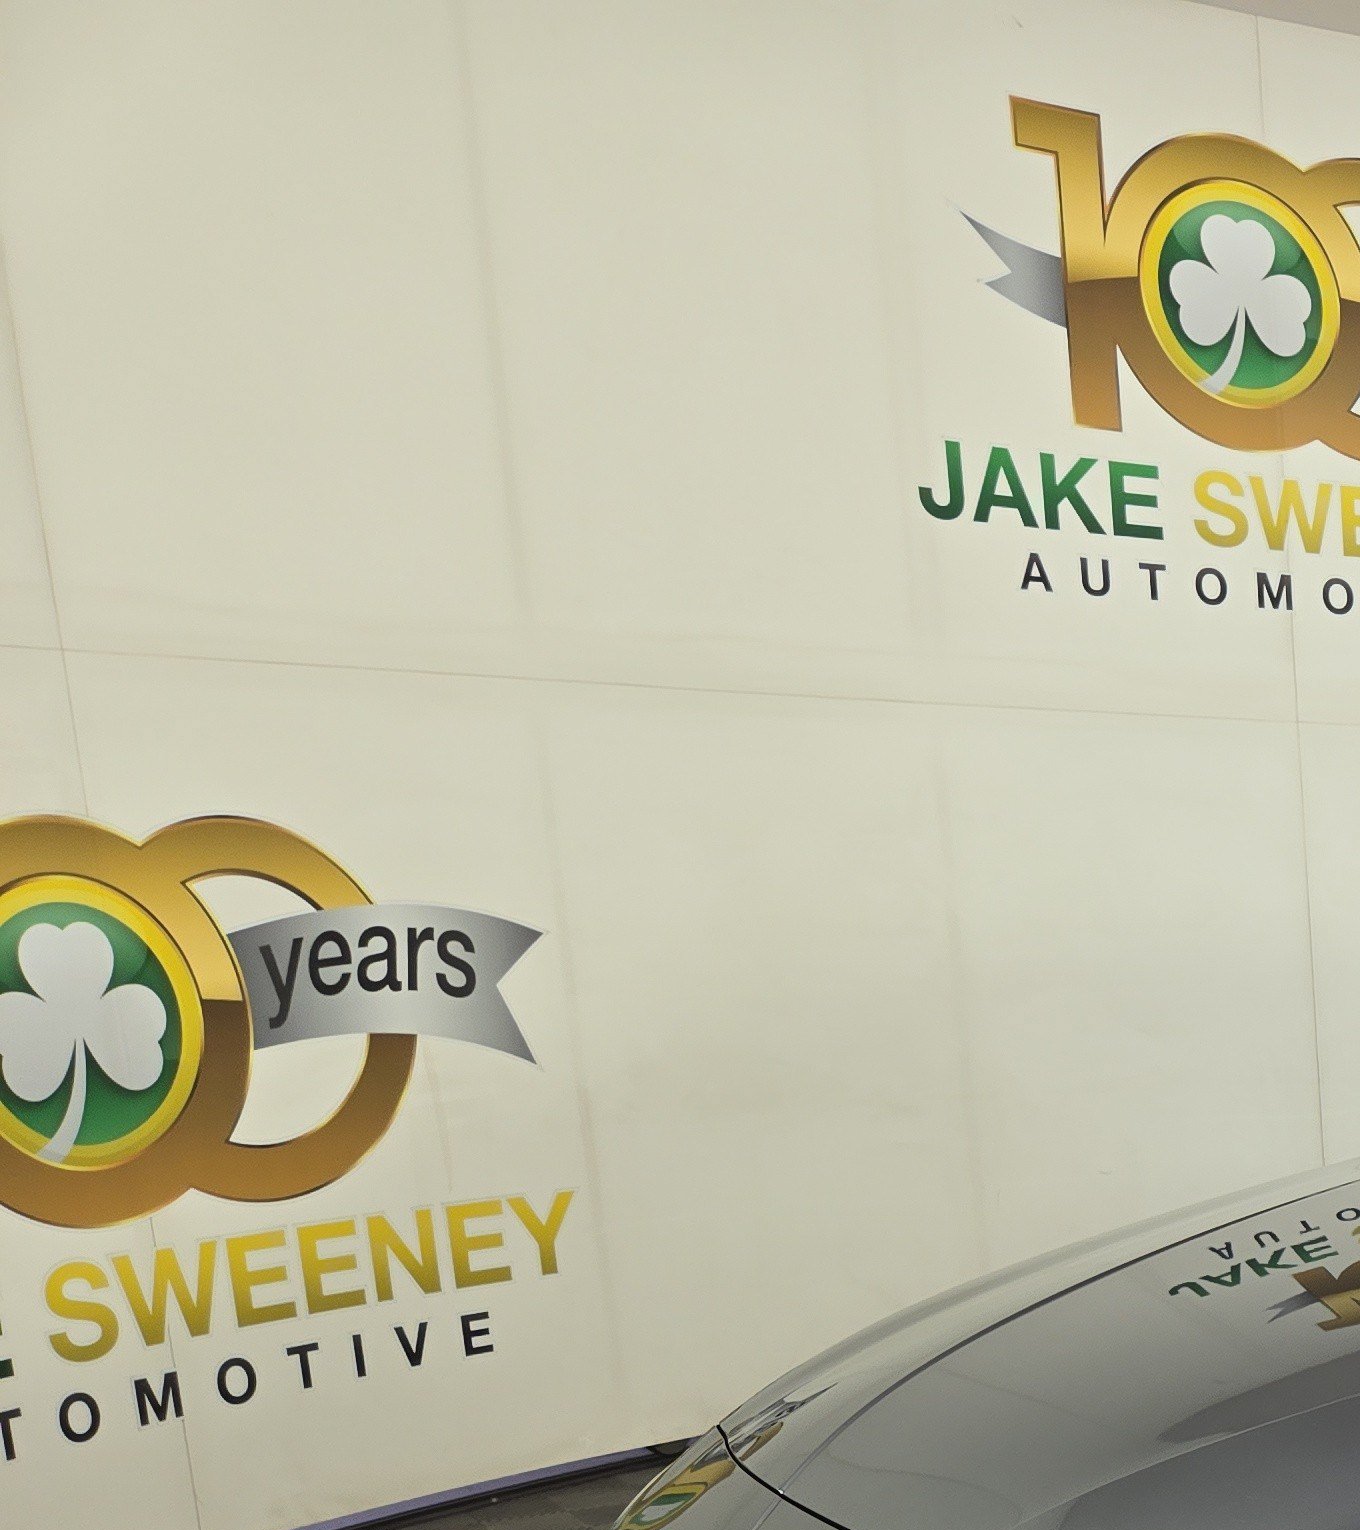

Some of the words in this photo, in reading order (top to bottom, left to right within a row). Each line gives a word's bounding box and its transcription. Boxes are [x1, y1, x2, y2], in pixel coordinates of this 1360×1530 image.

[918, 439, 1165, 541] JAKE
[259, 925, 478, 1030] years
[44, 1190, 576, 1363] SWEENEY
[0, 1310, 495, 1462] TOMOTIVE
